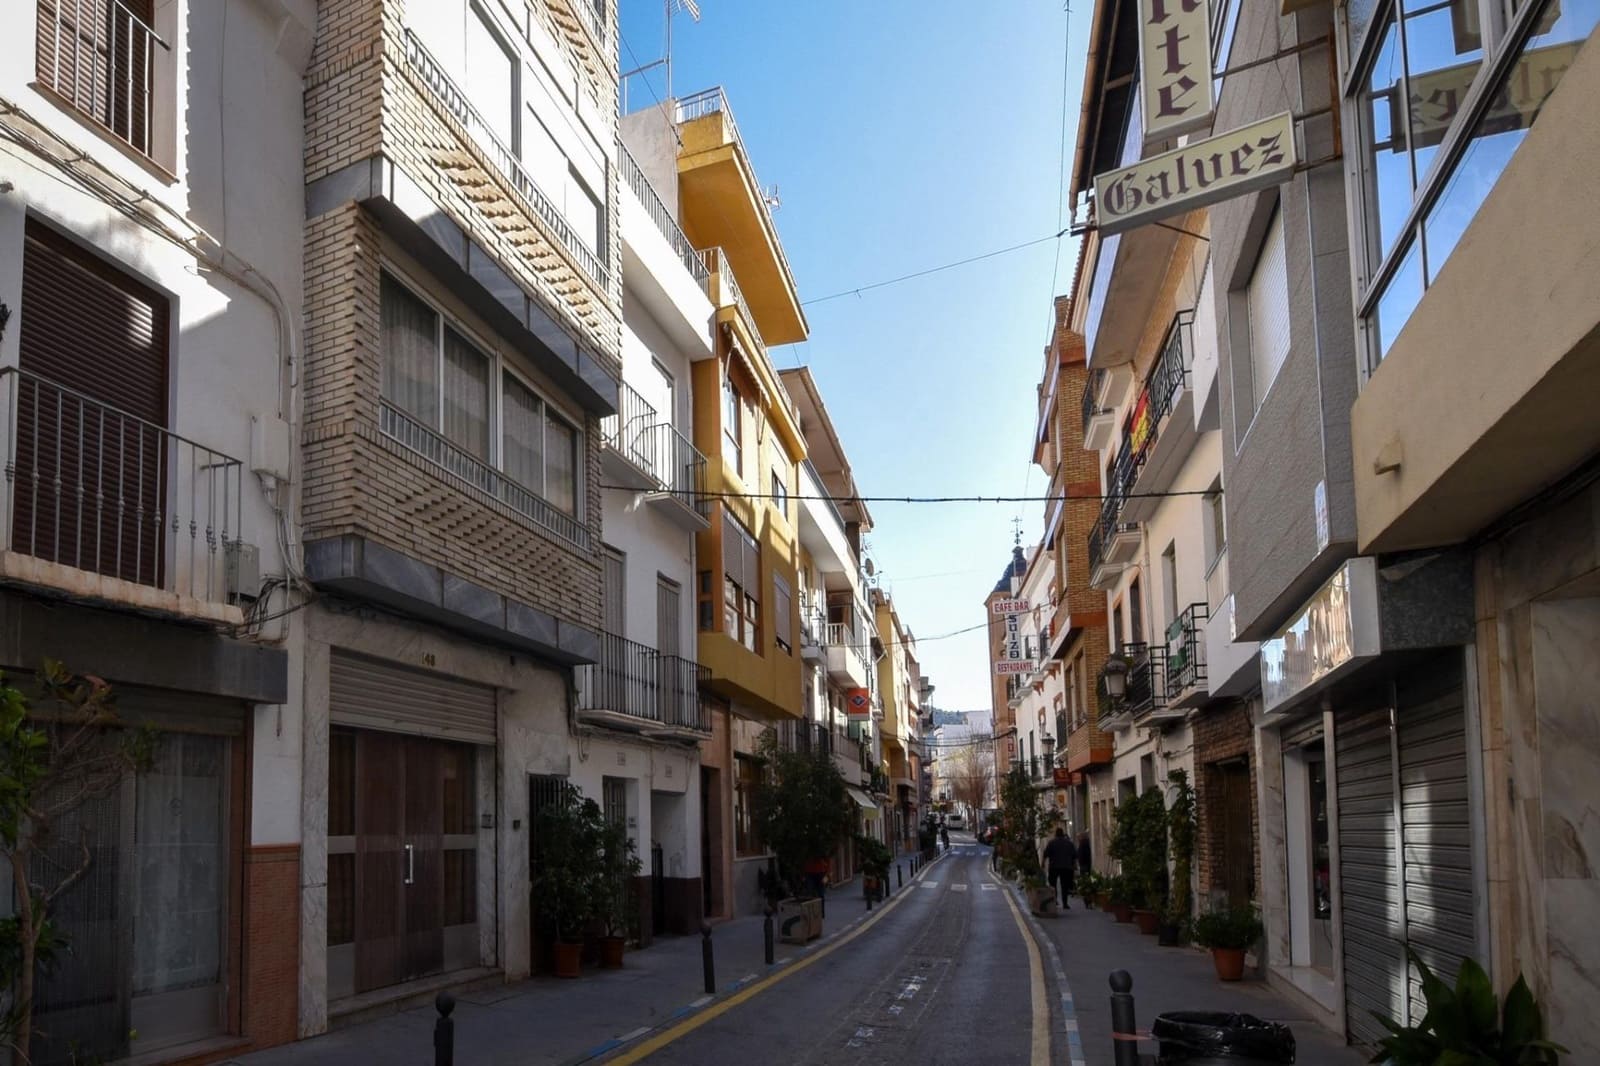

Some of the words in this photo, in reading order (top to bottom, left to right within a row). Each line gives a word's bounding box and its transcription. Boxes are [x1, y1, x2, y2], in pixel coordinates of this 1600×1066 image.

[1104, 130, 1284, 215] Galvez
[1014, 601, 1029, 611] BAR
[1008, 615, 1020, 658] SUIZO
